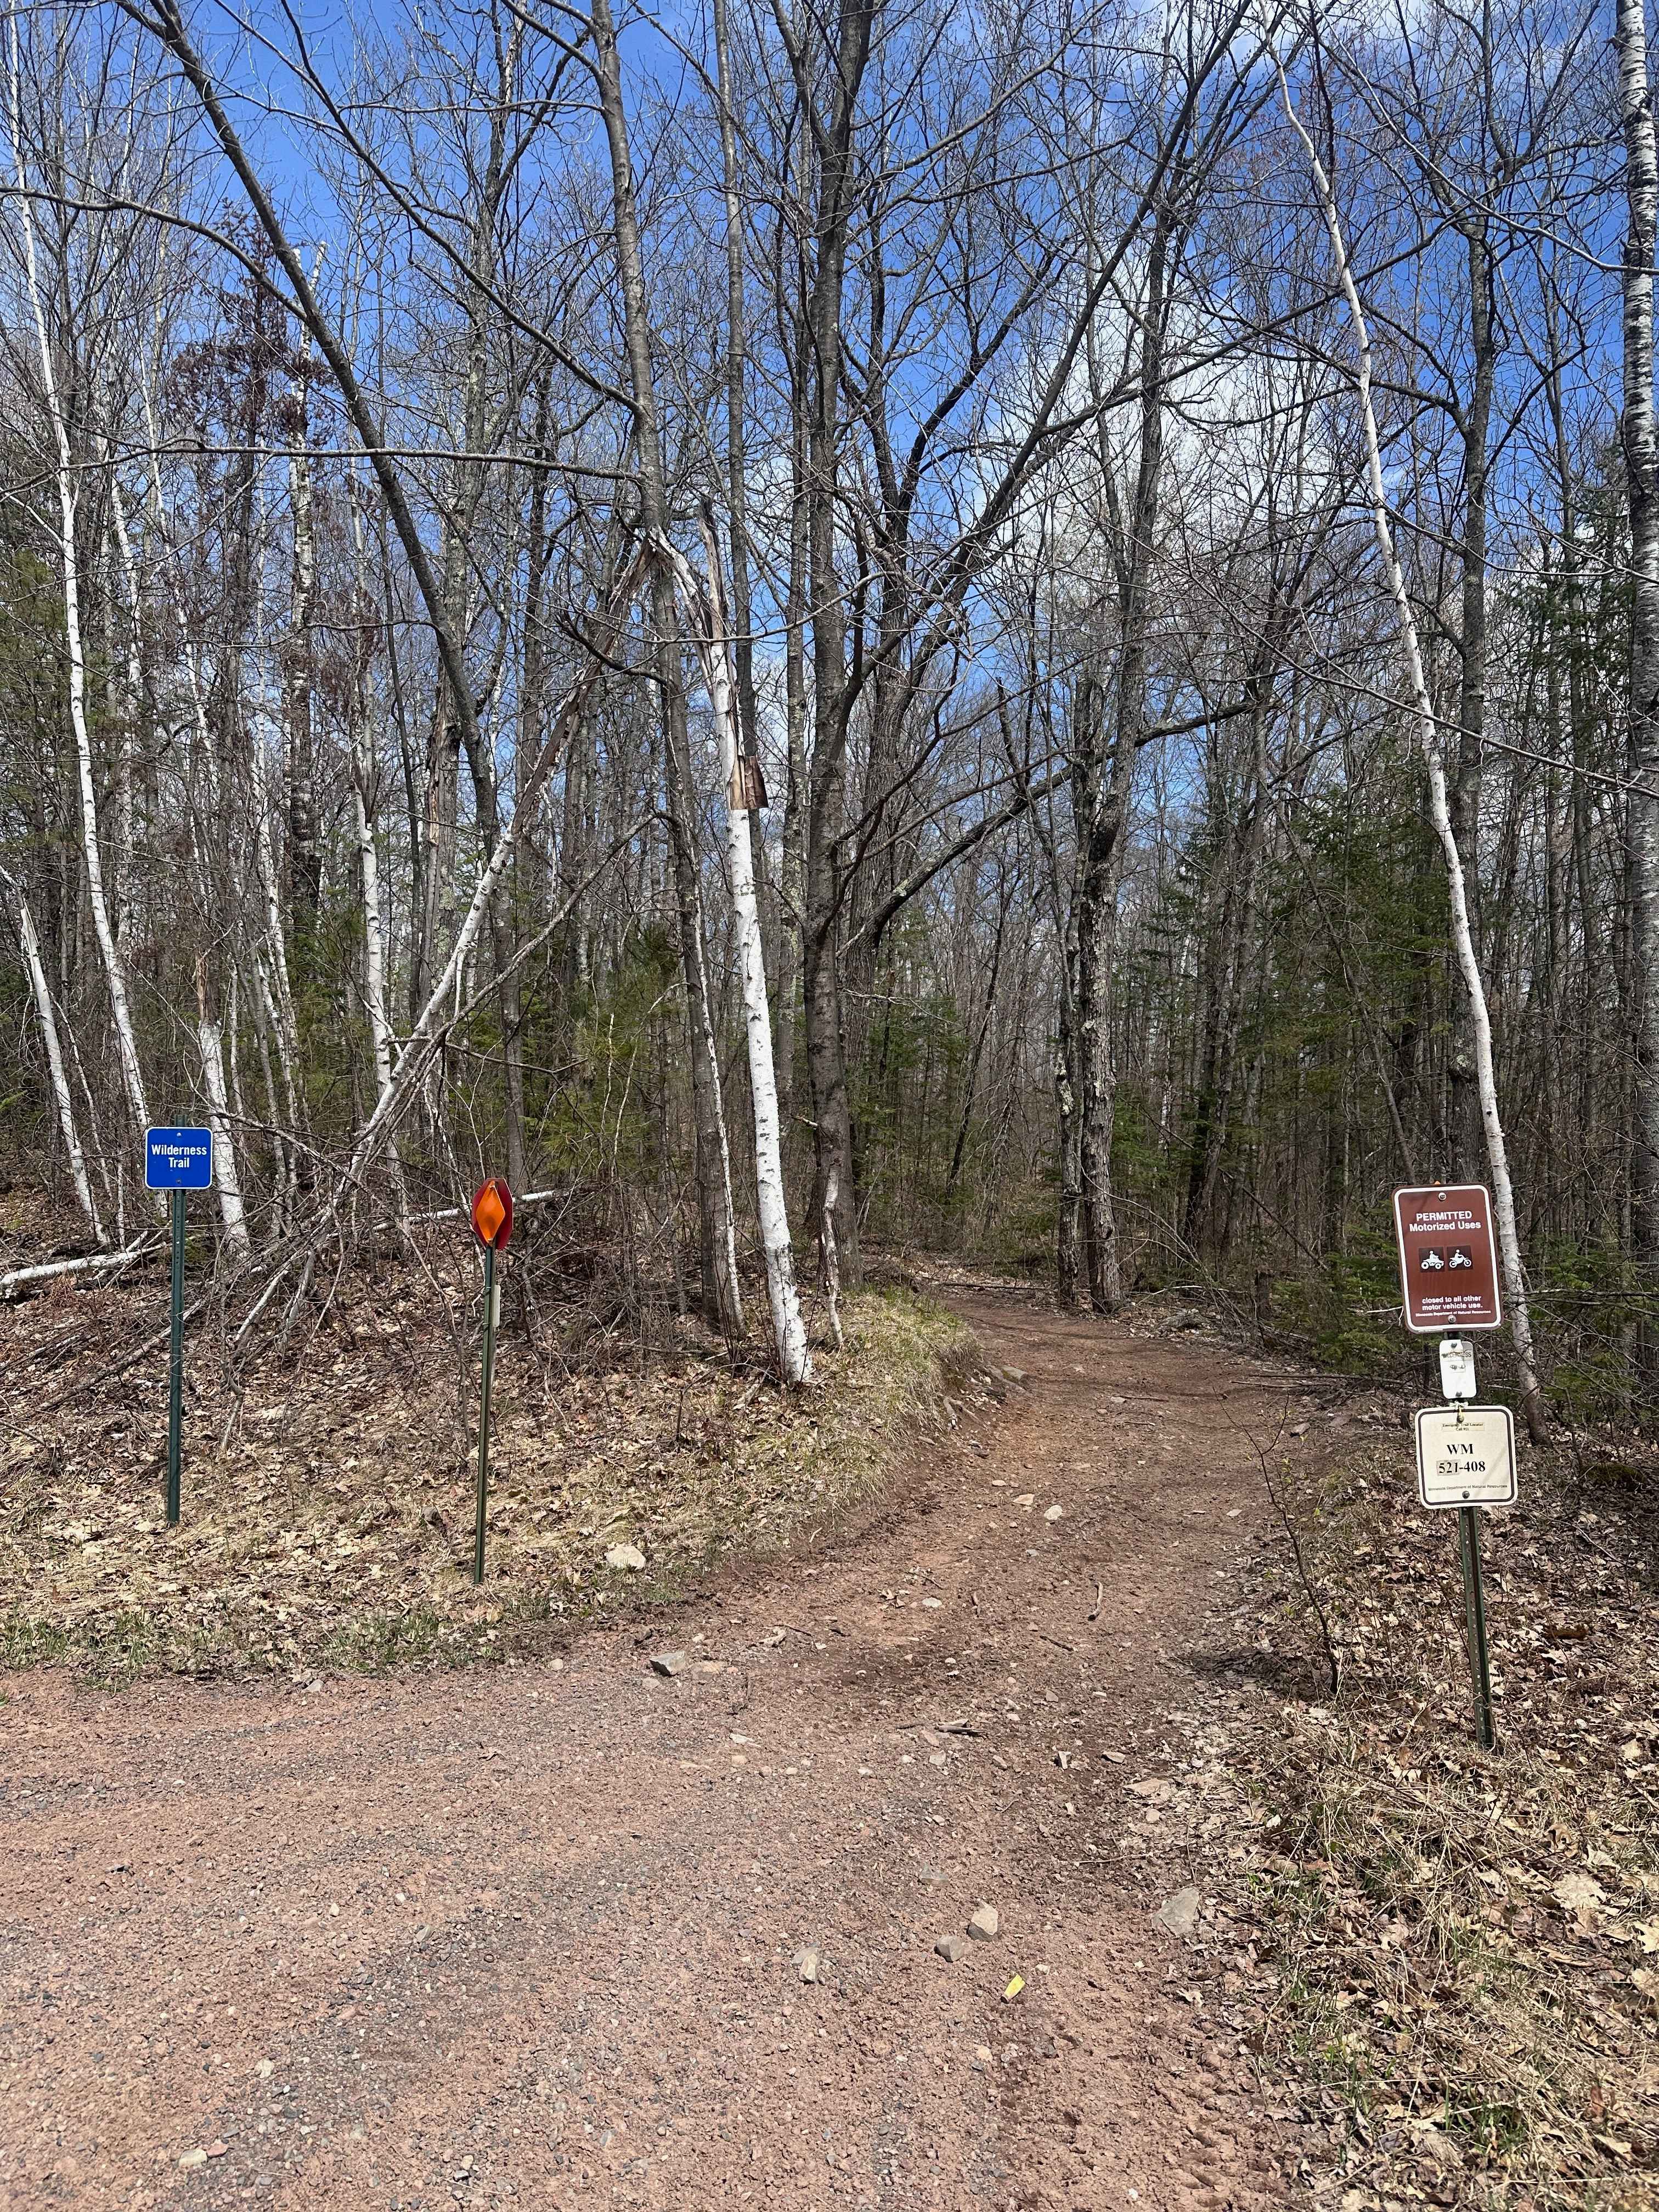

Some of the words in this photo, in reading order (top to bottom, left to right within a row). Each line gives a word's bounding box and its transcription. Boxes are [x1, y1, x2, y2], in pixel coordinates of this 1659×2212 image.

[151, 1144, 207, 1155] Wilderness
[168, 1157, 190, 1168] Trail
[1416, 1211, 1472, 1221] PERMITTED
[1409, 1222, 1455, 1232] Motorized
[1457, 1221, 1481, 1229] Uses
[1447, 1443, 1474, 1454] WM
[1438, 1461, 1485, 1474] 521-408
